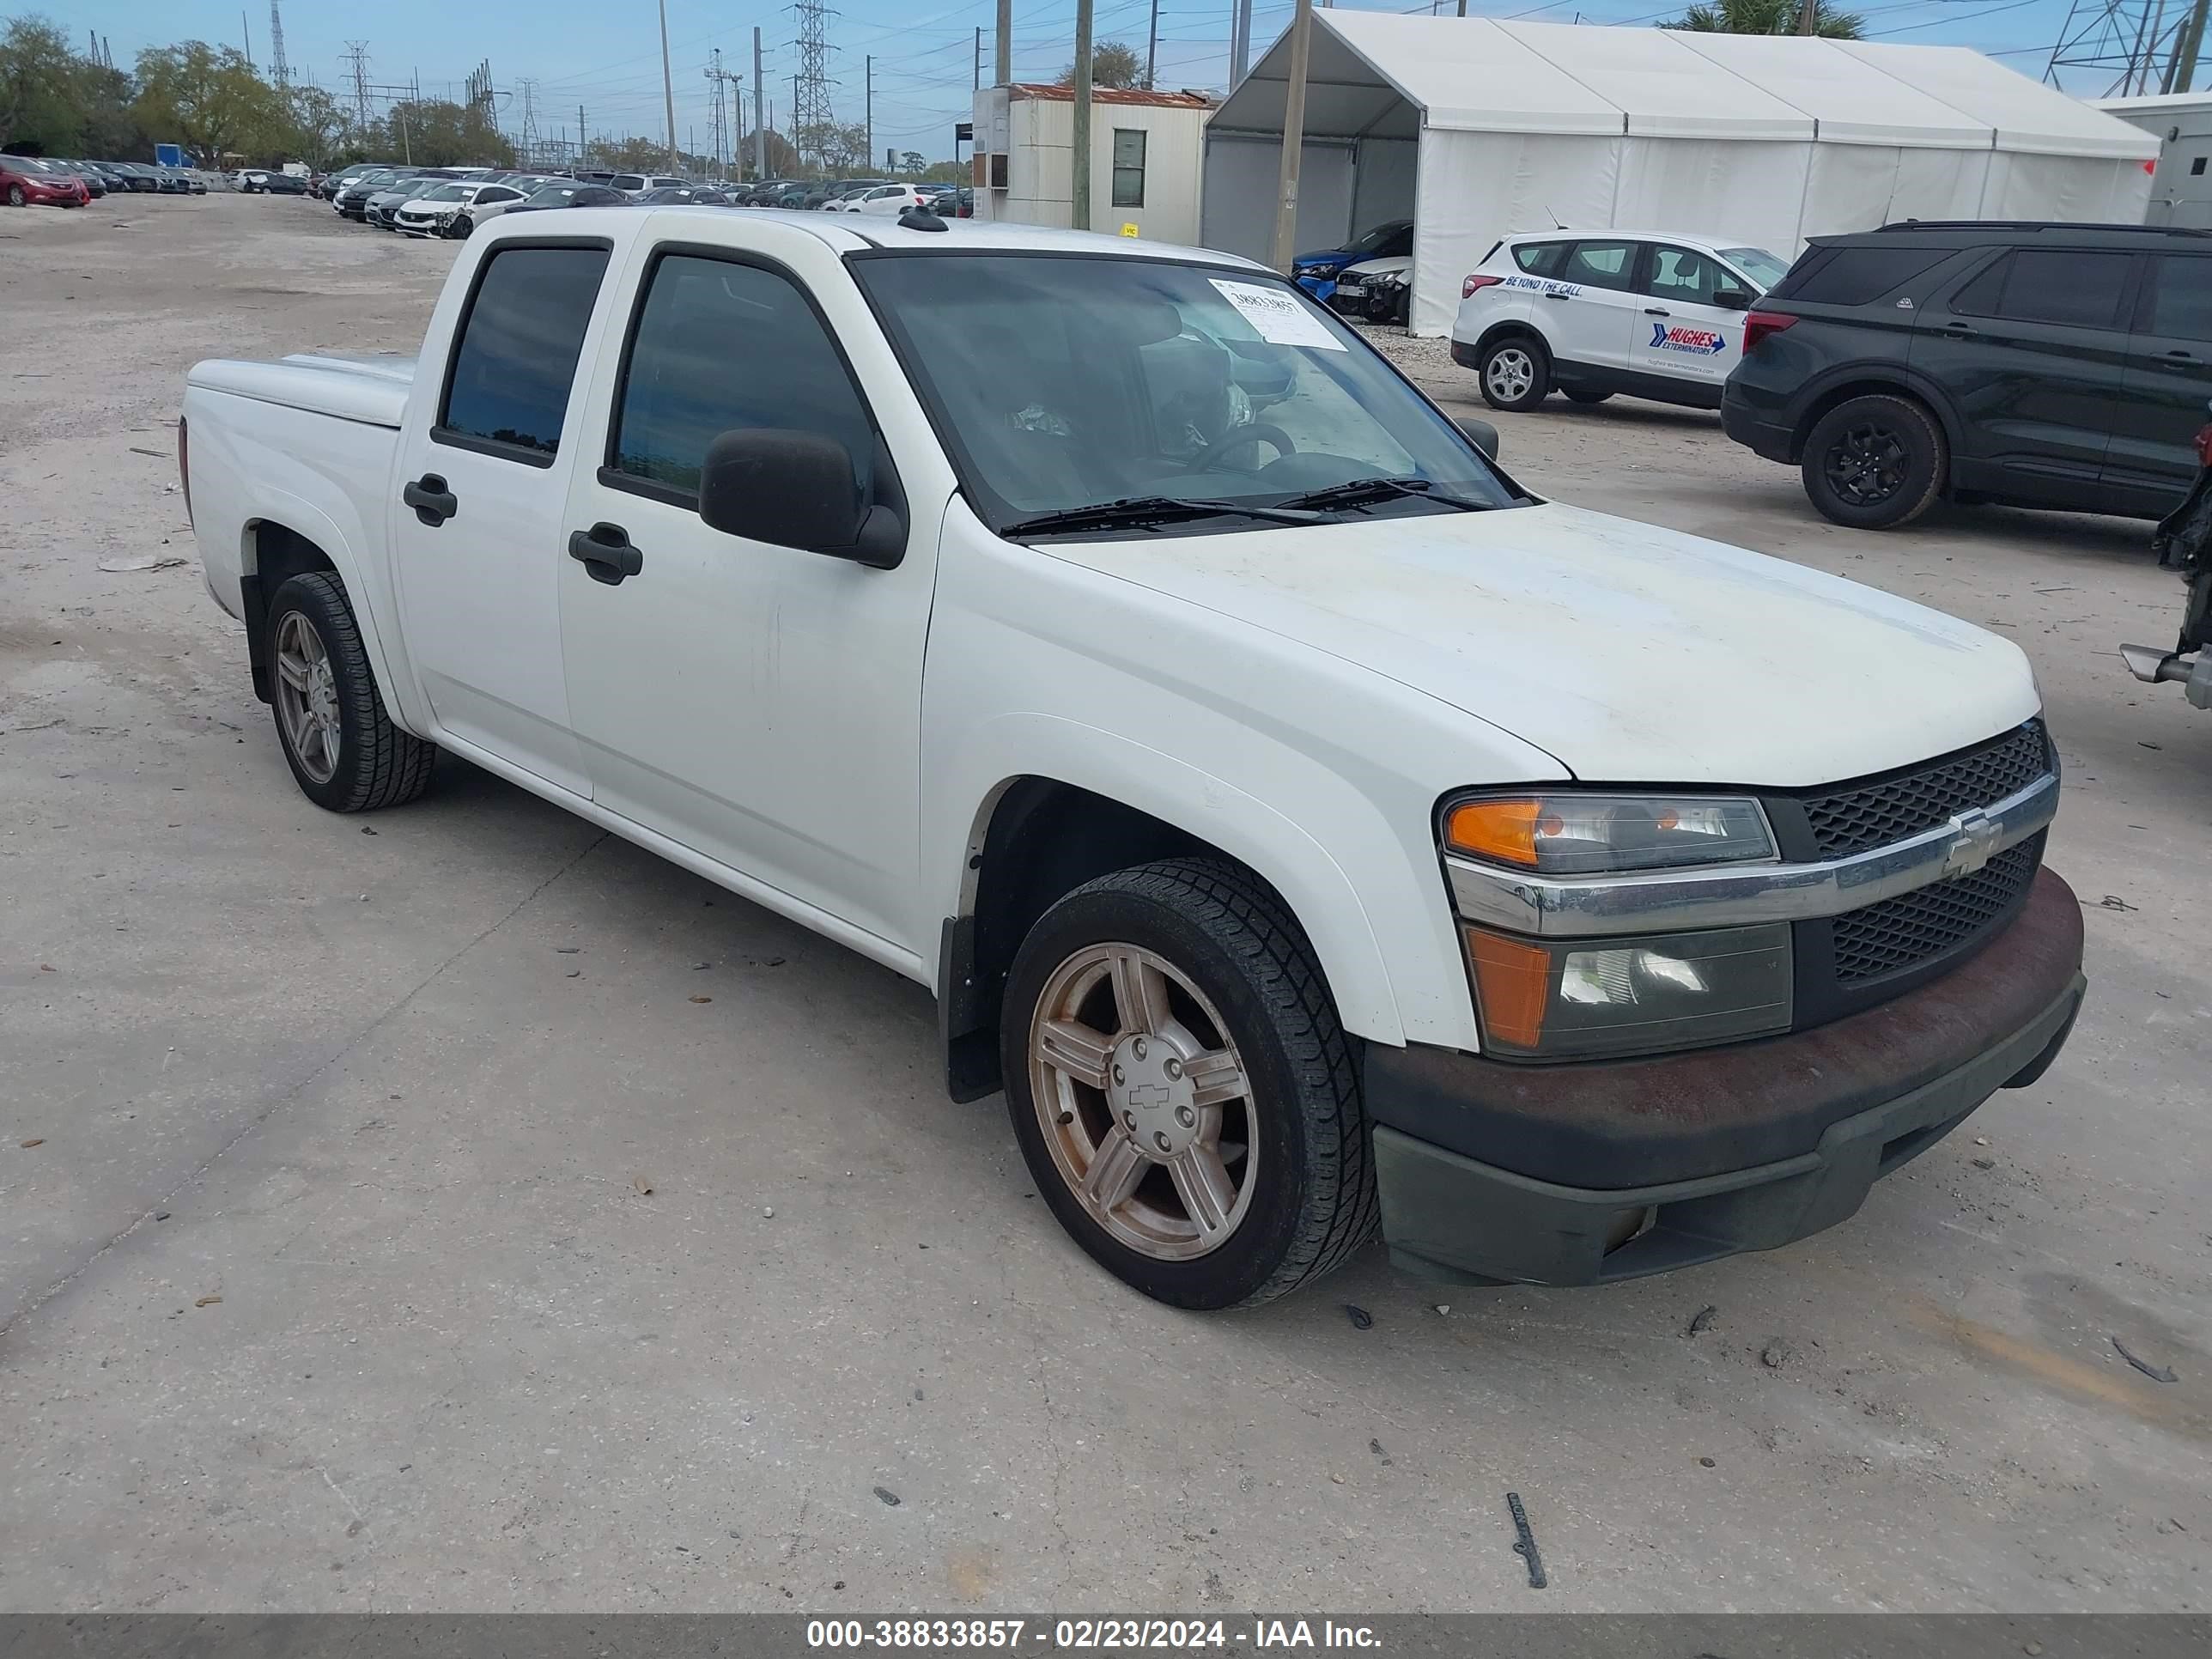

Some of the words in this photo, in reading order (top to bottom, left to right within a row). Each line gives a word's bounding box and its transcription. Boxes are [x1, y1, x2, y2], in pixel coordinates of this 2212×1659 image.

[1505, 276, 1540, 289] BEYOND
[1540, 282, 1559, 293] THE
[1559, 284, 1582, 296] CALL
[1231, 292, 1299, 314] 38833857
[1668, 327, 1716, 347] HUGHES
[1662, 342, 1711, 356] EXTERMINATORS
